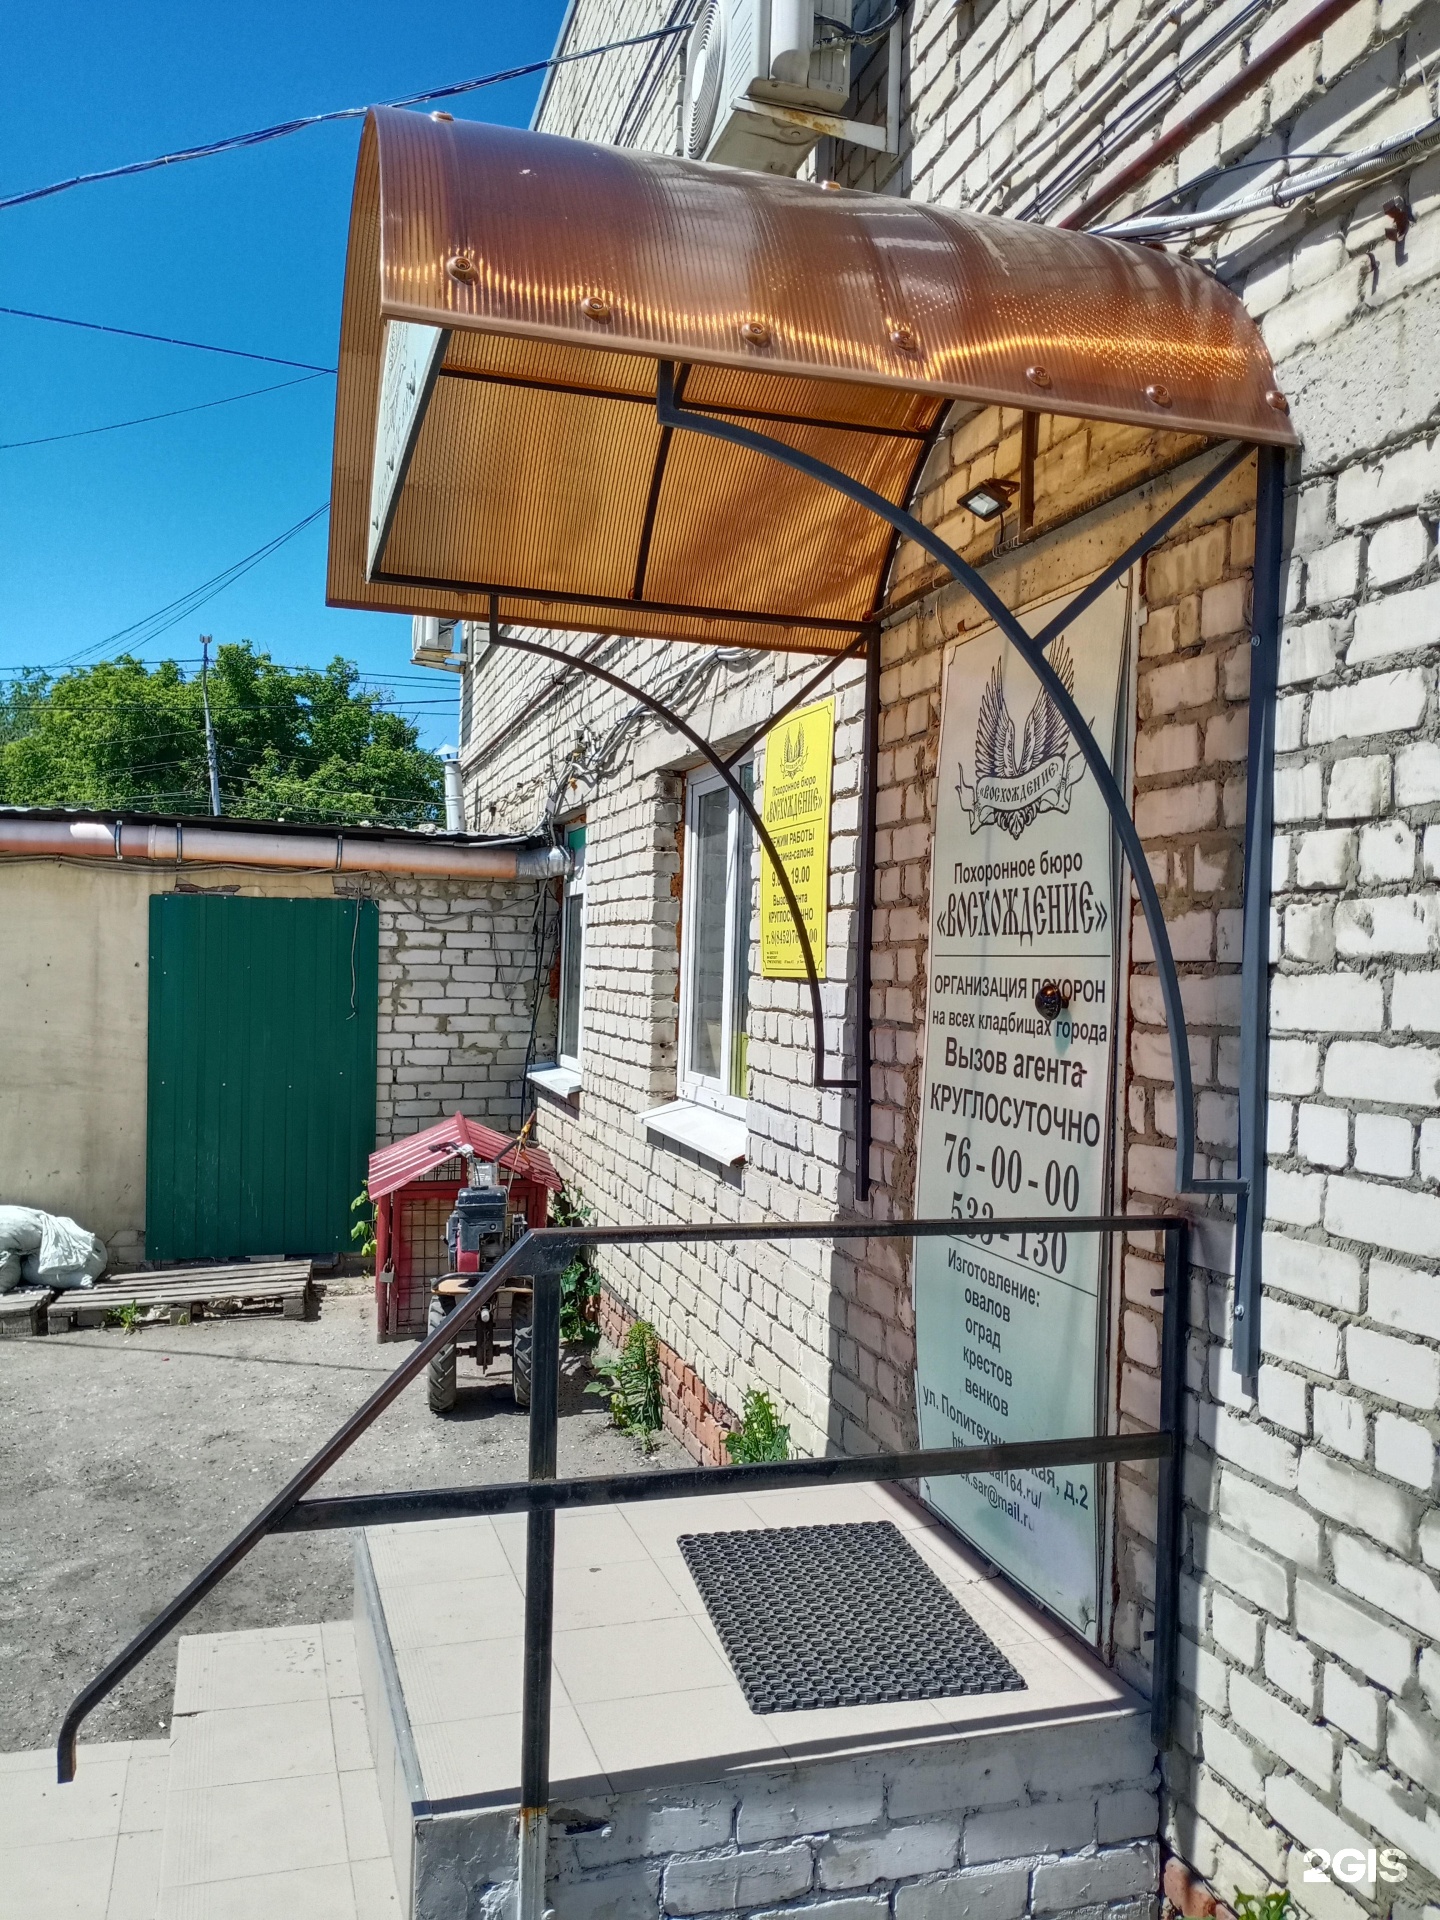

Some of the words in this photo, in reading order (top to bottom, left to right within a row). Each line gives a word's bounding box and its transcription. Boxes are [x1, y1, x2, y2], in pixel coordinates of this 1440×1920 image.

[772, 779, 800, 797] Похоронное
[800, 775, 817, 789] бюро
[789, 828, 815, 845] РАБОТЫ
[791, 865, 811, 885] 19.00
[954, 858, 1036, 887] Похоронное
[1040, 849, 1083, 880] бюро
[768, 907, 814, 924] КРУГЛОСЧНО
[937, 880, 1108, 947] «ВОСХОЖДЕНИЕ»
[934, 974, 1027, 1002] ОРГАНИЗАЦИЯ
[932, 1009, 945, 1026] на
[948, 1012, 975, 1029] всех
[978, 1011, 1052, 1038] кладбищах
[1055, 1020, 1108, 1046] города
[944, 1036, 1007, 1075] Вызов
[1013, 1053, 1084, 1089] агента
[930, 1082, 1101, 1148] КРУГЛОСУТОЧНО
[947, 1247, 1041, 1308] Изготовление:
[964, 1286, 1011, 1323] овалов
[965, 1317, 1002, 1354] оград
[963, 1345, 1014, 1388] крестов
[964, 1377, 1010, 1418] венков
[922, 1385, 939, 1410] ул.
[1063, 1479, 1089, 1511] д.2
